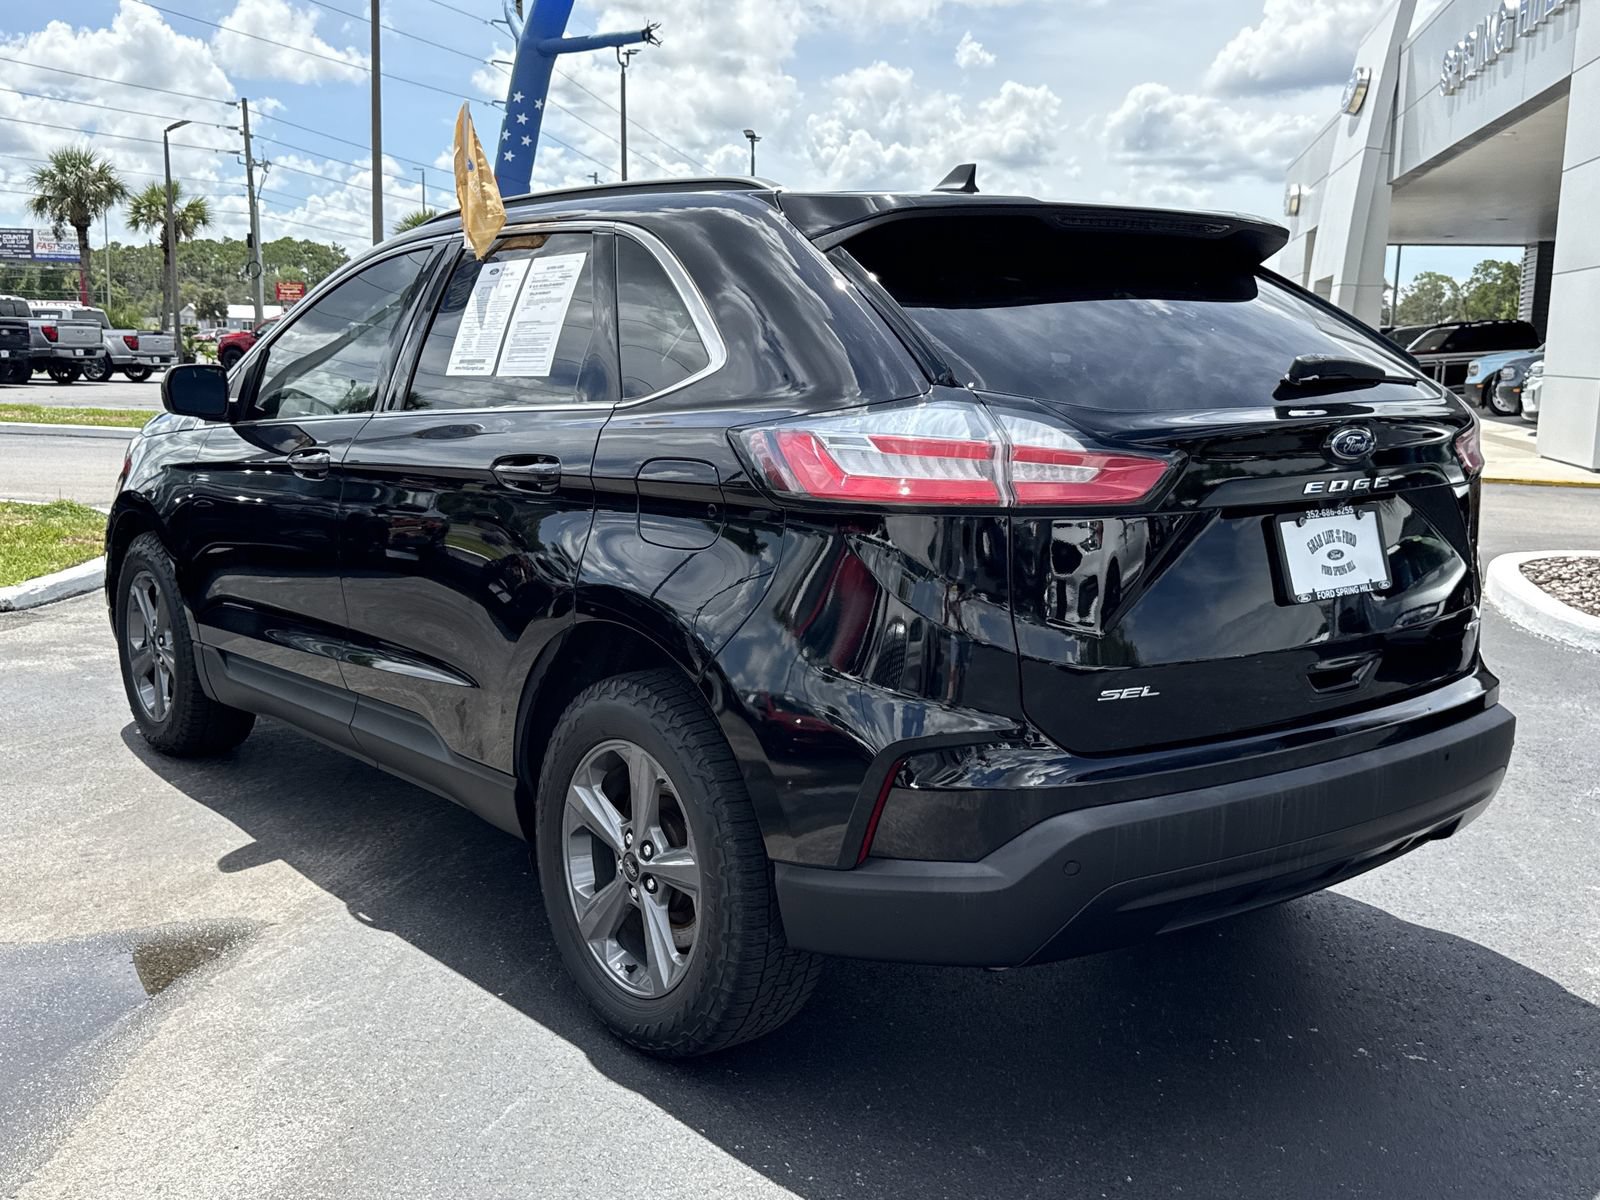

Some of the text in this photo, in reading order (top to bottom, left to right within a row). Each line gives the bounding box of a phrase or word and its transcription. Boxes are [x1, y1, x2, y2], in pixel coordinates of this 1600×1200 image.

[1303, 476, 1390, 494] EDGE
[1306, 534, 1324, 555] GRAB
[1322, 529, 1336, 545] LIFE
[1342, 530, 1357, 547] FORD
[1321, 560, 1357, 576] FORD SPRING HILL
[1316, 590, 1336, 600] FORD
[1336, 585, 1360, 597] SPRING
[1360, 583, 1374, 593] HILL
[1097, 685, 1160, 701] SEL
